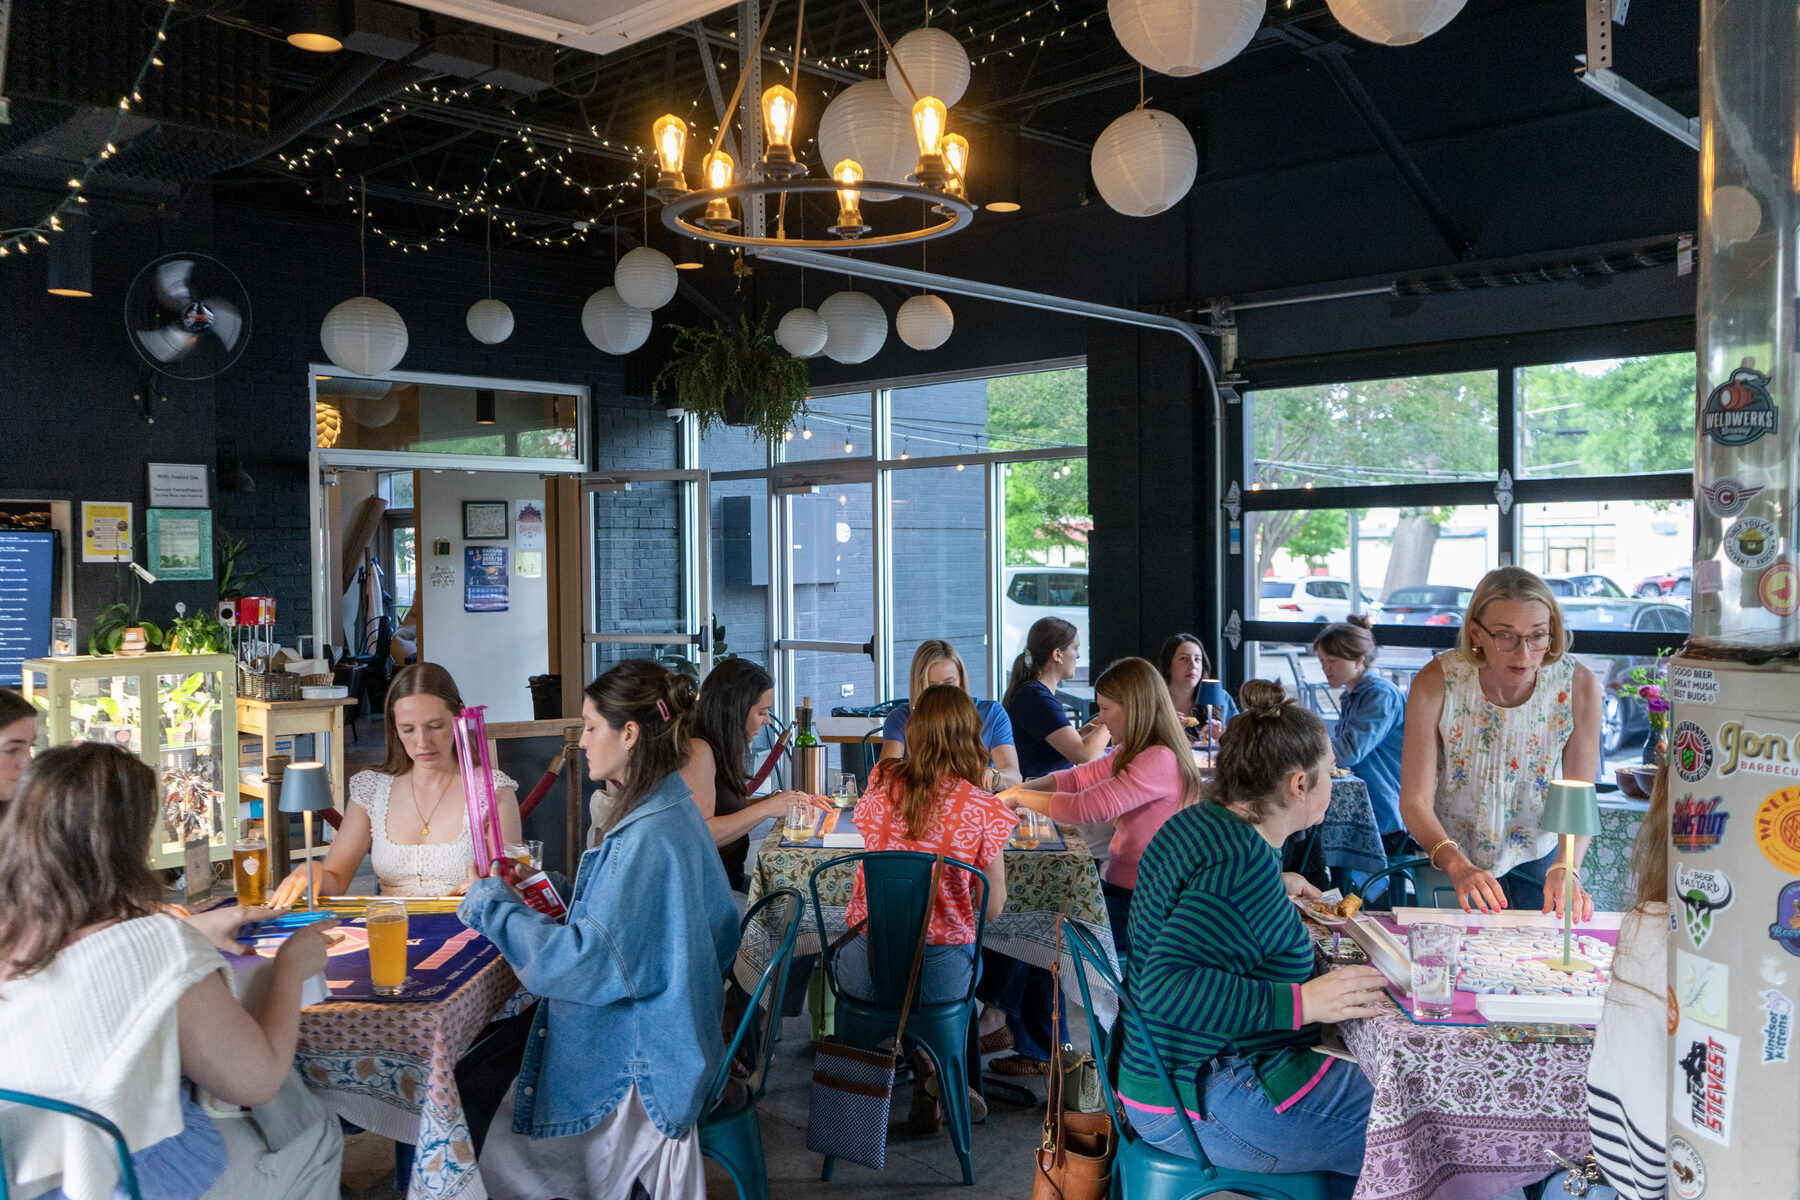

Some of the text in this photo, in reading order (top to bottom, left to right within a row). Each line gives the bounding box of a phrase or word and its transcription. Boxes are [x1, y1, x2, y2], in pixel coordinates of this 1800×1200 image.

[1706, 411, 1773, 429] WELDWERKS
[1744, 520, 1760, 529] YOU
[1761, 521, 1775, 537] CAN
[1674, 667, 1713, 679] GOOD BEER
[1674, 678, 1719, 692] GREAT MUSIC
[1674, 689, 1707, 702] BEST BUDS
[1696, 813, 1729, 836] OUT
[1694, 871, 1715, 882] BEER
[1680, 876, 1721, 895] BASTARD
[1765, 1011, 1777, 1062] Windsor
[1691, 1082, 1707, 1129] THE
